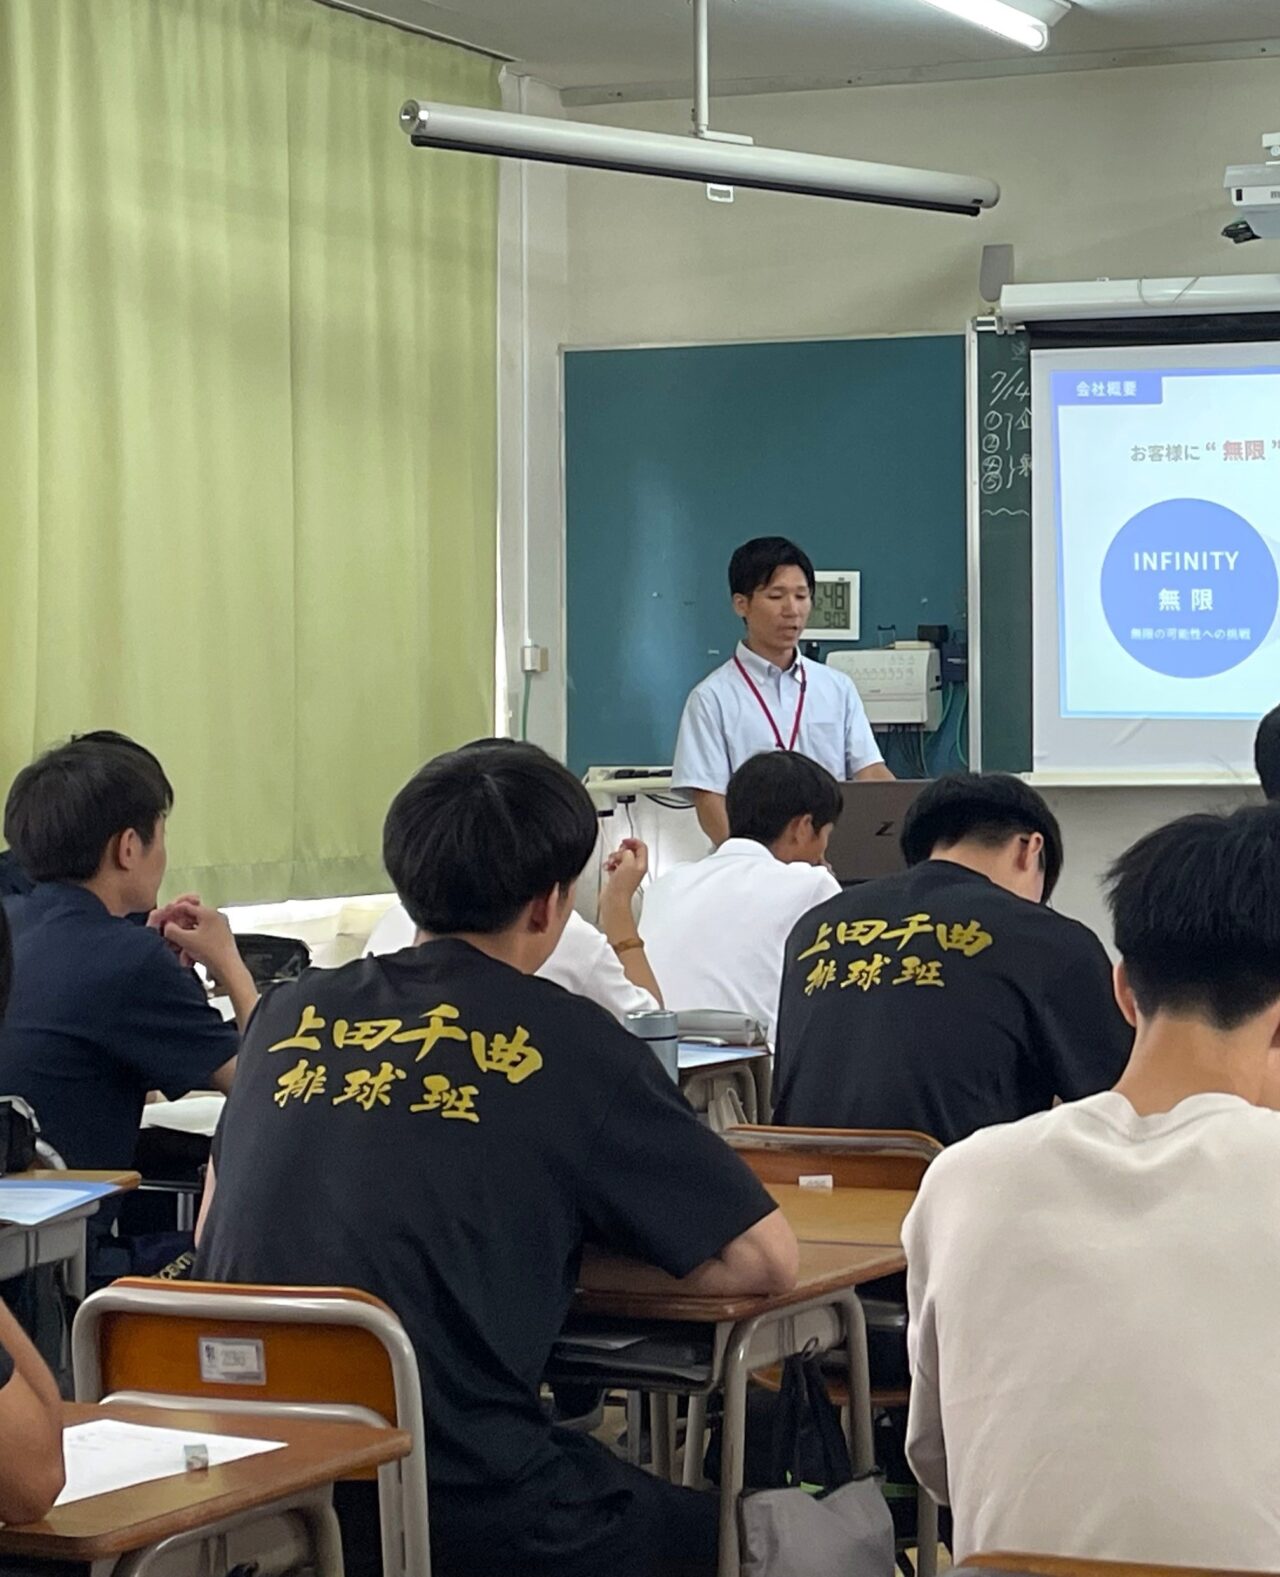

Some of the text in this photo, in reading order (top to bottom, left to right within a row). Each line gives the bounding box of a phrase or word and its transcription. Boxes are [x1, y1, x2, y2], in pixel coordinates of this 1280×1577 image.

[989, 367, 1030, 407] 7/14
[1076, 381, 1137, 397] 会社概要
[1134, 551, 1239, 571] INFINITY
[824, 582, 845, 610] 48
[797, 913, 993, 957] 上田千曲
[804, 953, 945, 996] 排球班
[268, 1004, 543, 1084] 上田千曲
[274, 1059, 480, 1123] 排球班
